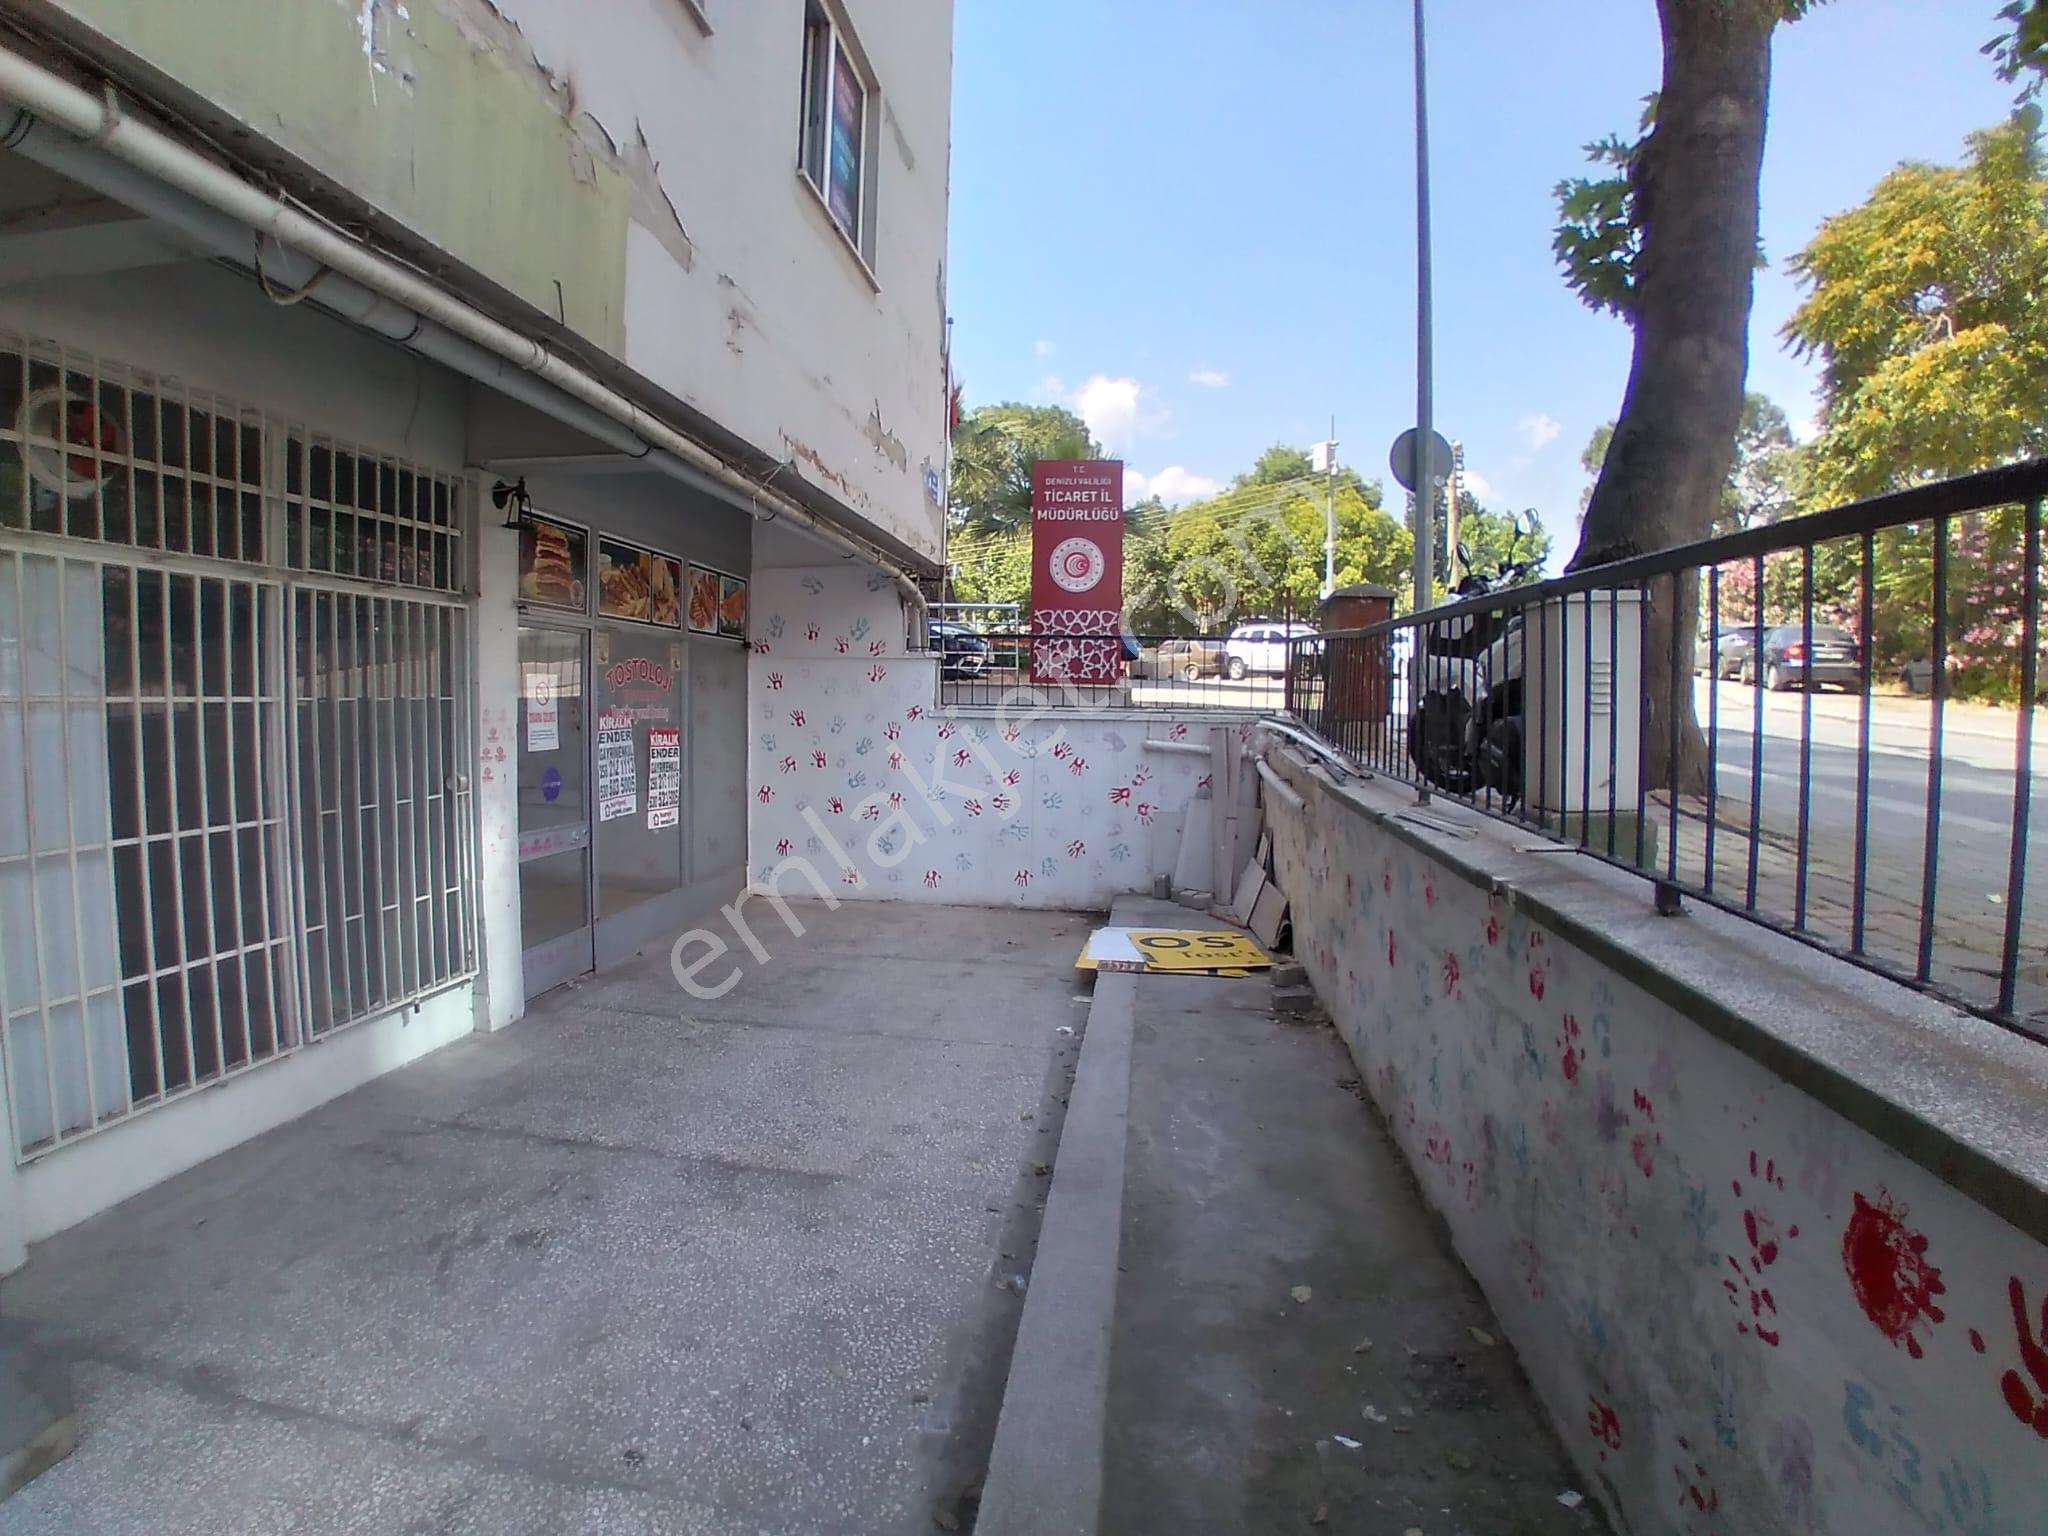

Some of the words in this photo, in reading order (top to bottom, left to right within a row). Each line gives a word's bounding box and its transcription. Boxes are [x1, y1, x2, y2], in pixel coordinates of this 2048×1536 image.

[1044, 488, 1098, 502] TİCARET
[1101, 488, 1113, 502] İL
[1037, 506, 1119, 521] MÜDÜRLÜĞÜ
[599, 714, 632, 731] KİRALIK
[599, 731, 632, 744] ENDER
[650, 732, 679, 746] KİRALIK
[651, 747, 679, 759] ENDER
